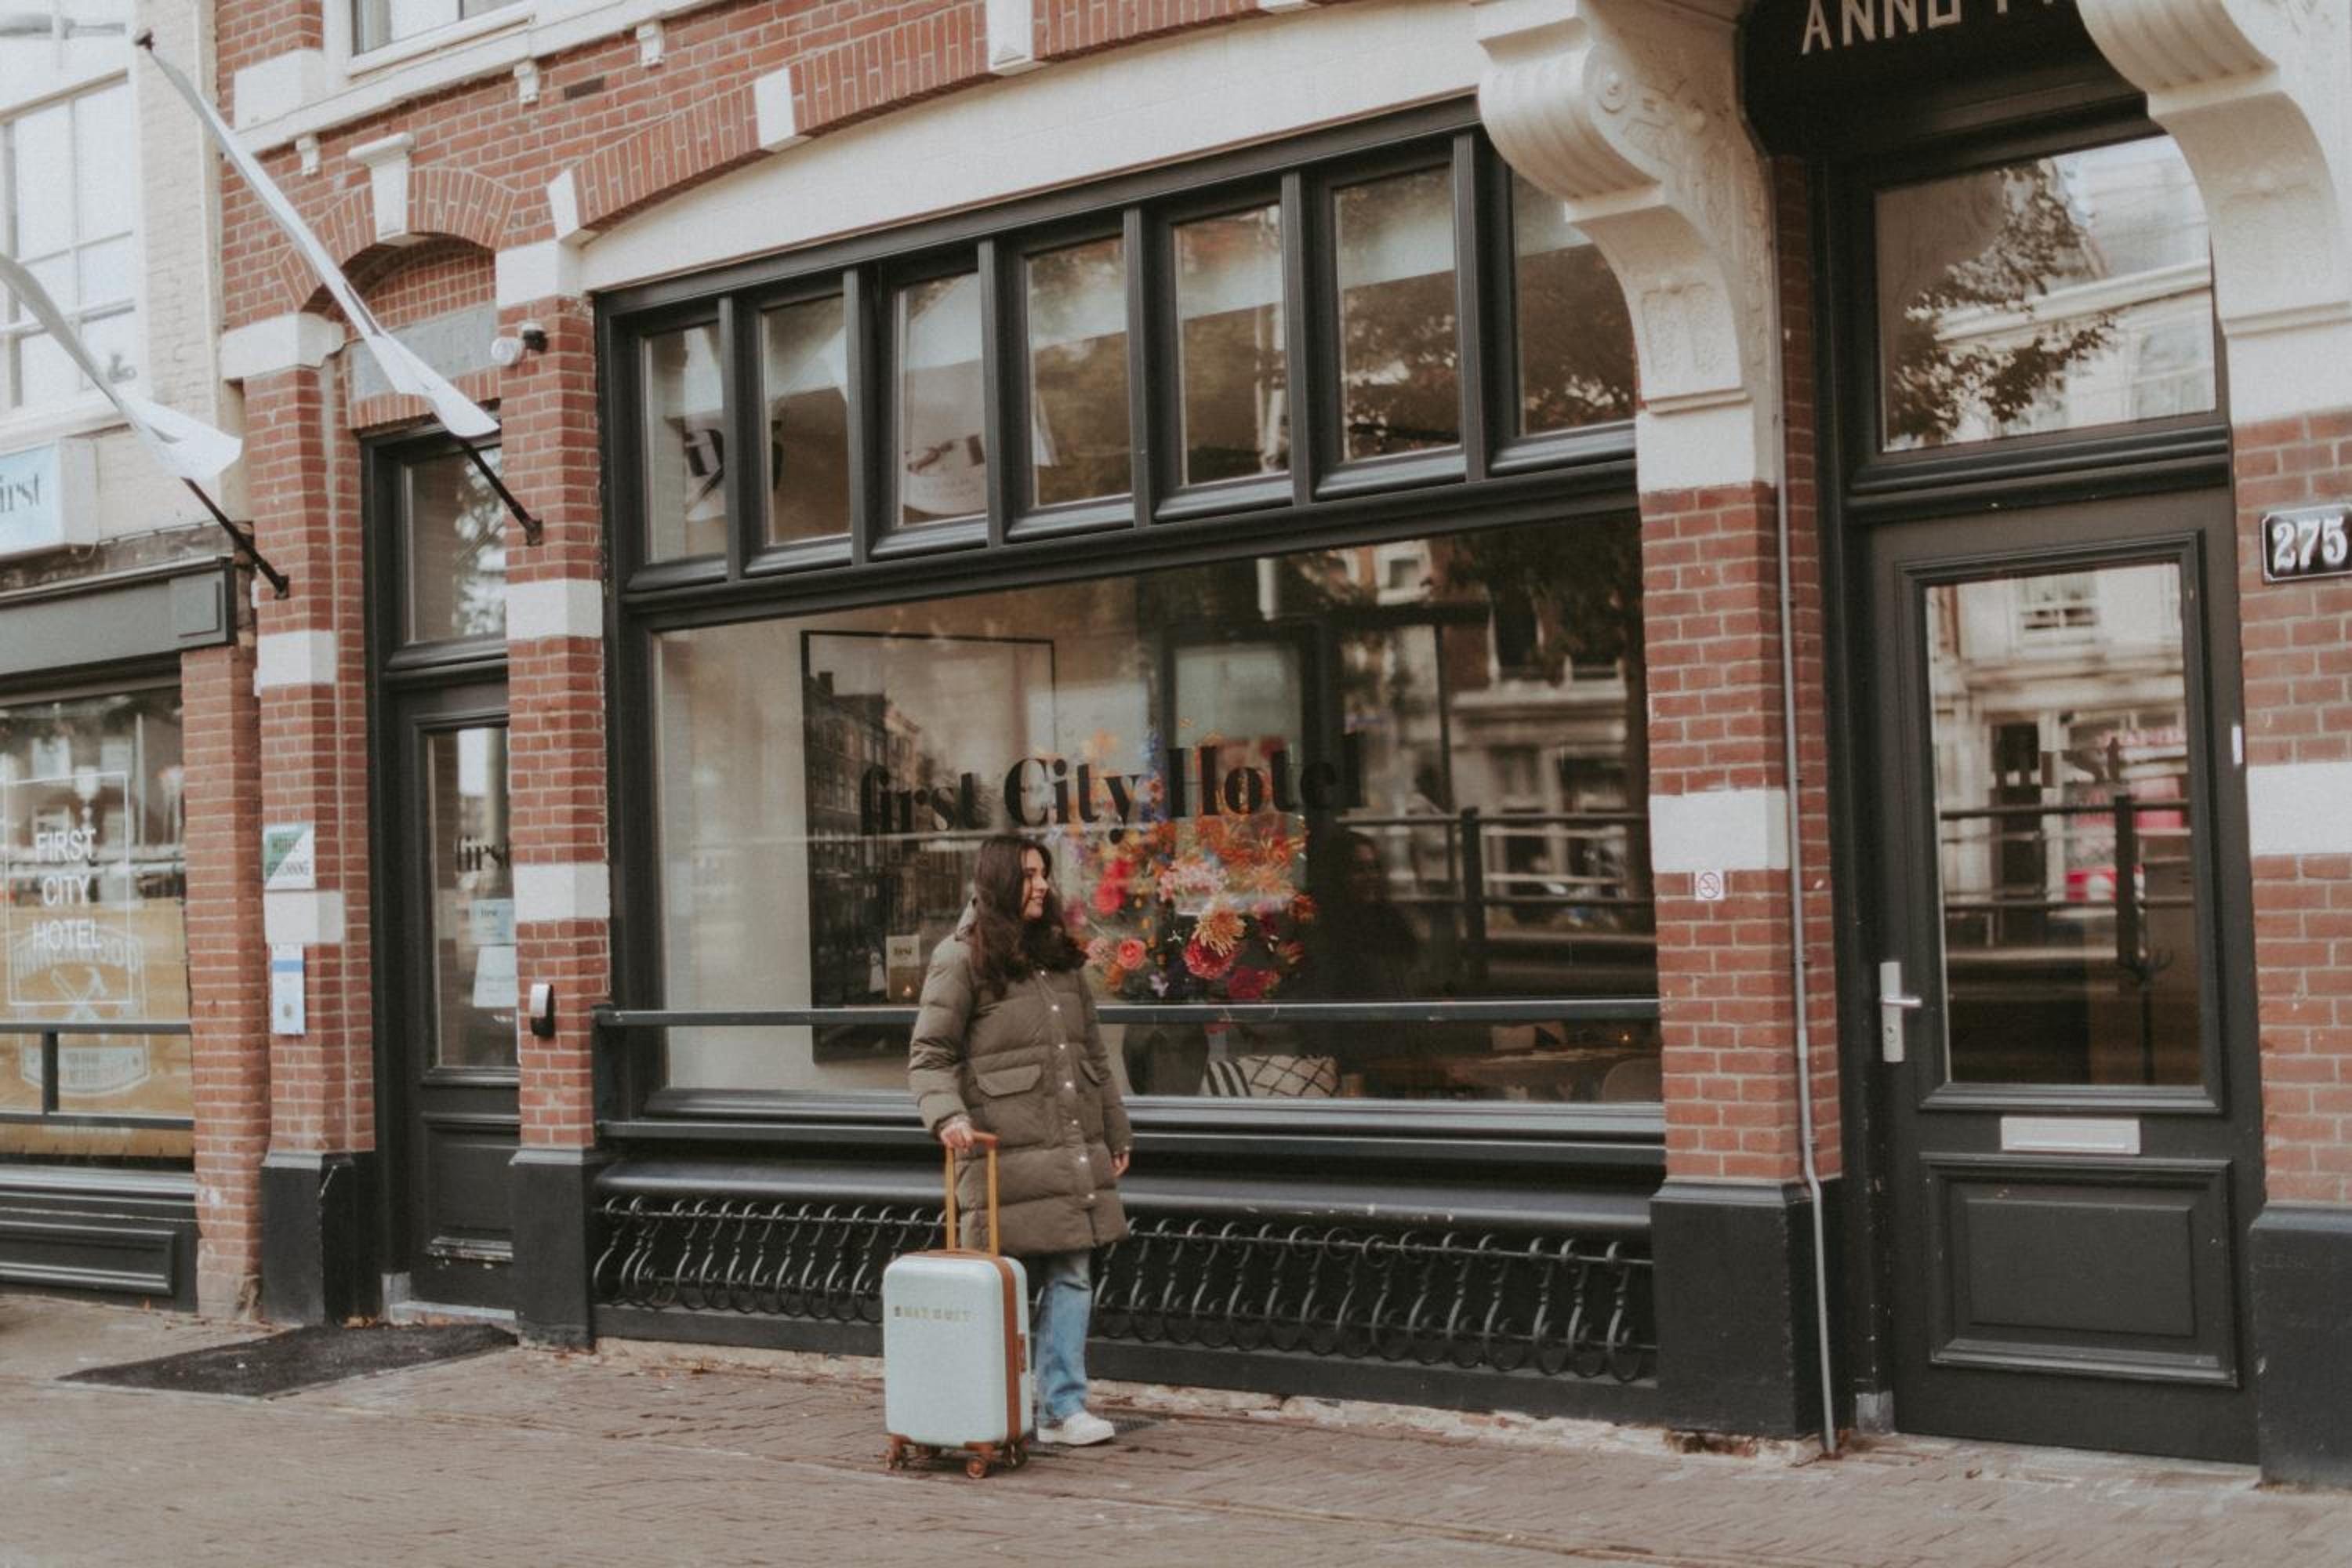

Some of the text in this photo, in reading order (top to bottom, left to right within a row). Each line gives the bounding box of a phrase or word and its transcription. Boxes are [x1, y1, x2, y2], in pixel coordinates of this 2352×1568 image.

[0, 473, 40, 514] irst
[2272, 515, 2348, 572] 275
[860, 732, 1365, 845] first City Hotel
[36, 828, 96, 862] FIRST
[42, 875, 91, 906] CITY
[32, 918, 102, 952] HOTEL
